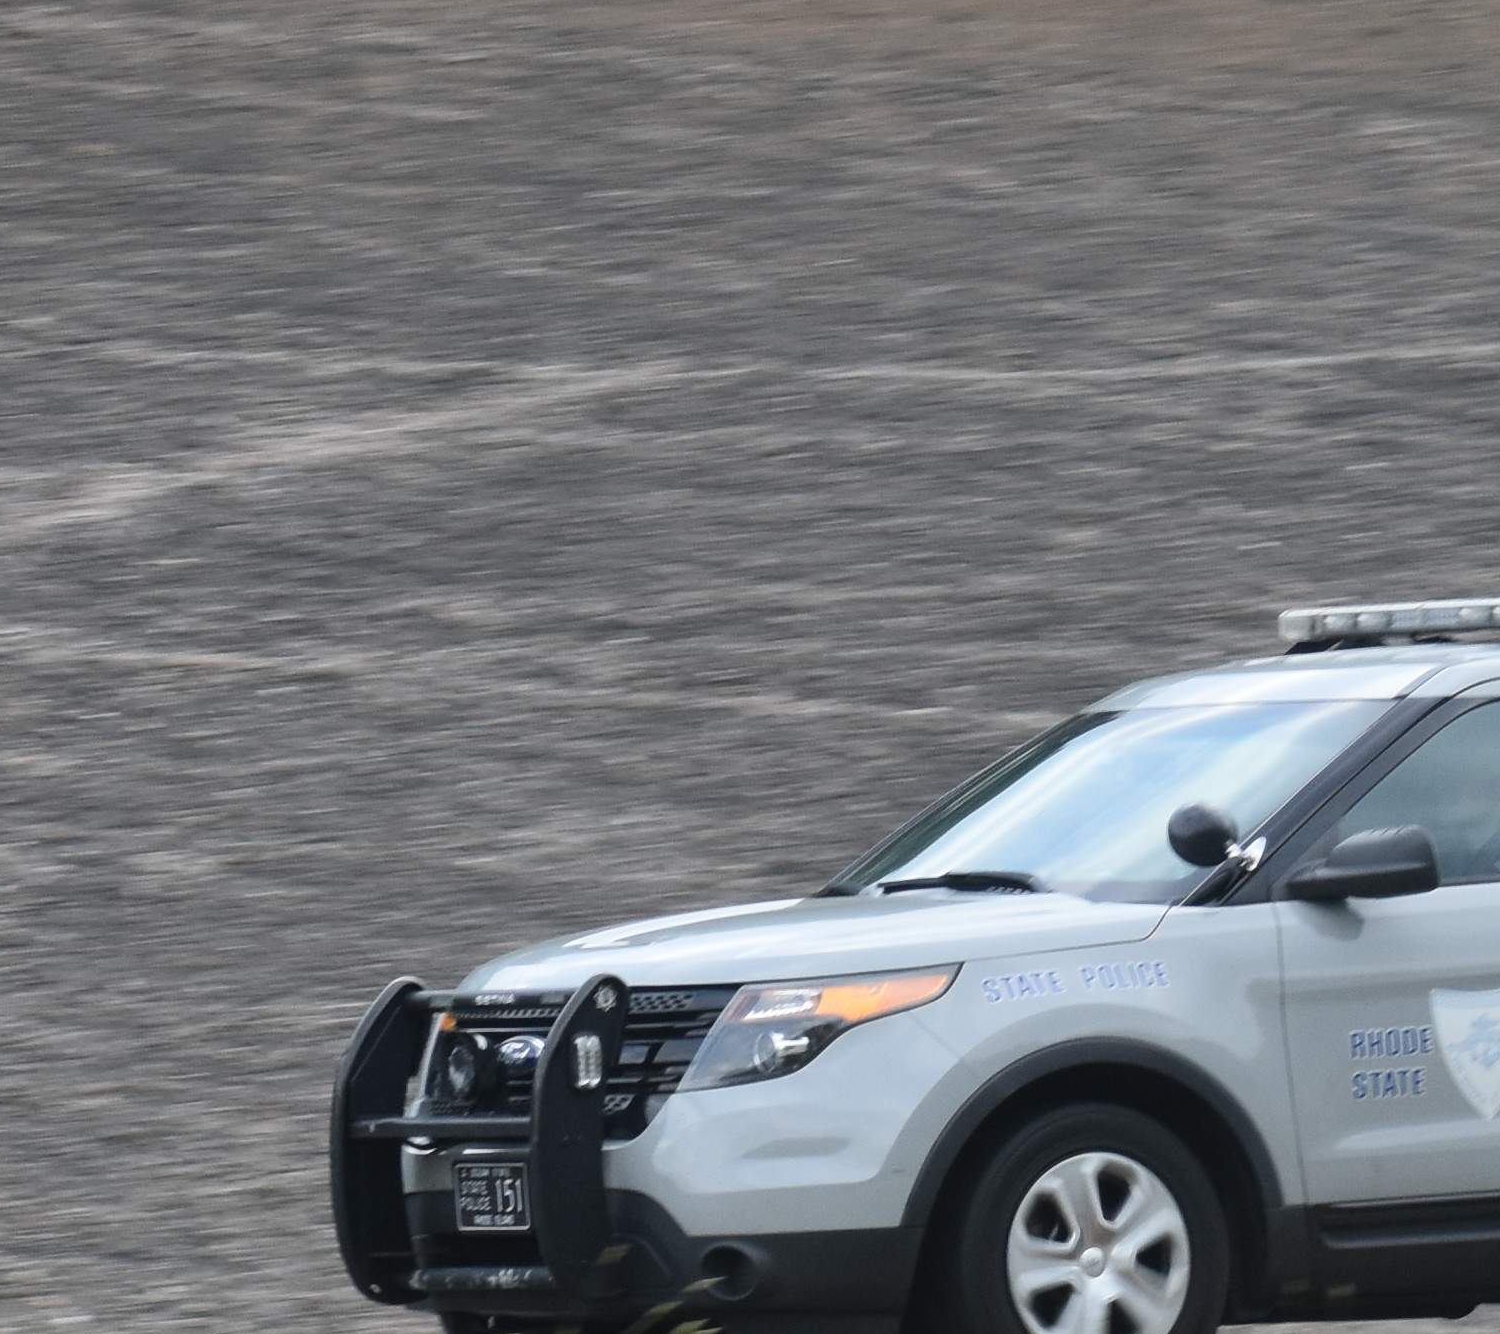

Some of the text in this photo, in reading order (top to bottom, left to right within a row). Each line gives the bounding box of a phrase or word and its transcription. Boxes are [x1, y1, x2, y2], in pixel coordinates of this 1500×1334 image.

[981, 960, 1170, 1003] STATE POLICE
[1349, 1025, 1434, 1059] RHODE
[1351, 1067, 1427, 1101] STATE
[495, 1178, 523, 1213] 151
